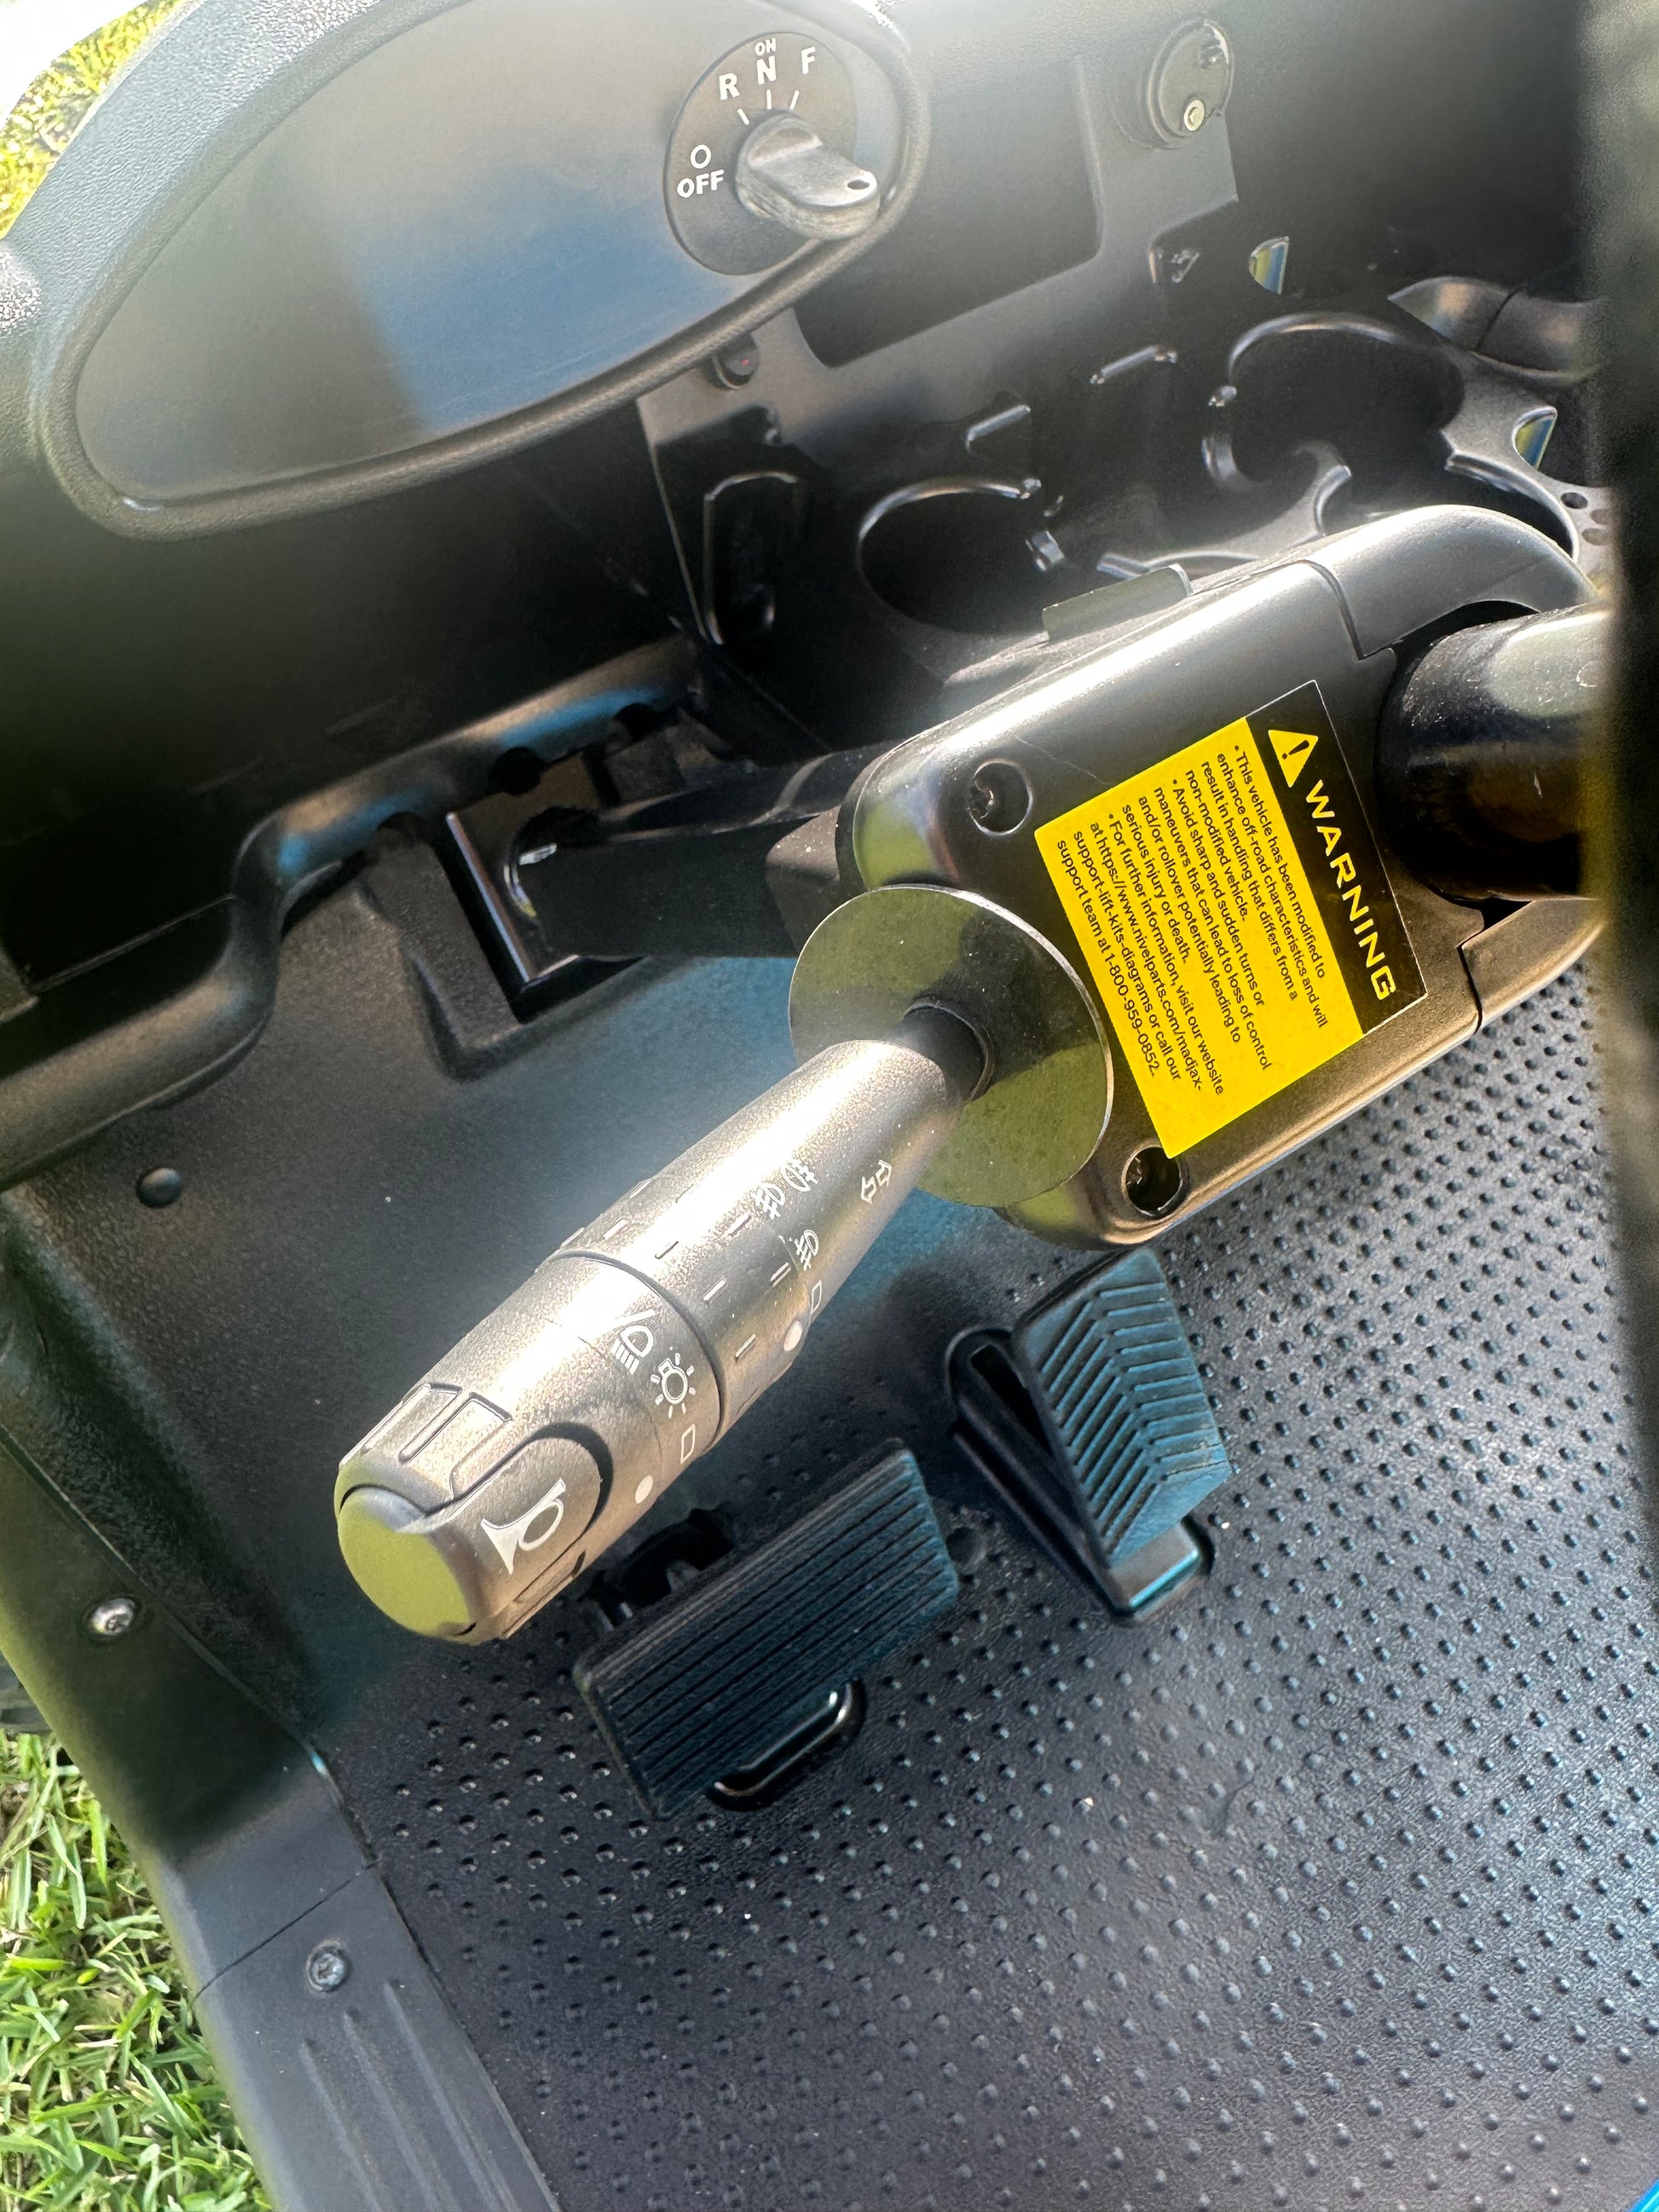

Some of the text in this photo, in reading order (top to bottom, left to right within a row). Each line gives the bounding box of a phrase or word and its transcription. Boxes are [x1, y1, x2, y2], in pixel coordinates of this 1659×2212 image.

[719, 46, 816, 101] R N F
[754, 38, 777, 56] ON
[676, 170, 725, 199] OFF
[1056, 840, 1160, 1078] support team at 1-800-959-0852.
[1072, 830, 1182, 1081] support-lift-kits-diagrams or call our
[1090, 822, 1203, 1091] at https://www.nivelparts.com/madjax-
[1108, 819, 1224, 1096] For further information, visit our website
[1121, 804, 1191, 964] serious injury or death.
[1137, 795, 1241, 1043] and/or rollover potentially leading to
[1153, 786, 1273, 1071] maneuvers that can lead to loss of control
[1172, 788, 1265, 1006] Avoid sharp and sudden turns or
[1184, 769, 1249, 922] non-modified vehicle.
[1200, 760, 1298, 1002] result in handling that differs from a
[1217, 753, 1329, 1029] enhance off-road characteristics and will
[1235, 750, 1326, 979] This vehicle has been modified to
[1305, 779, 1396, 1001] WARNING
